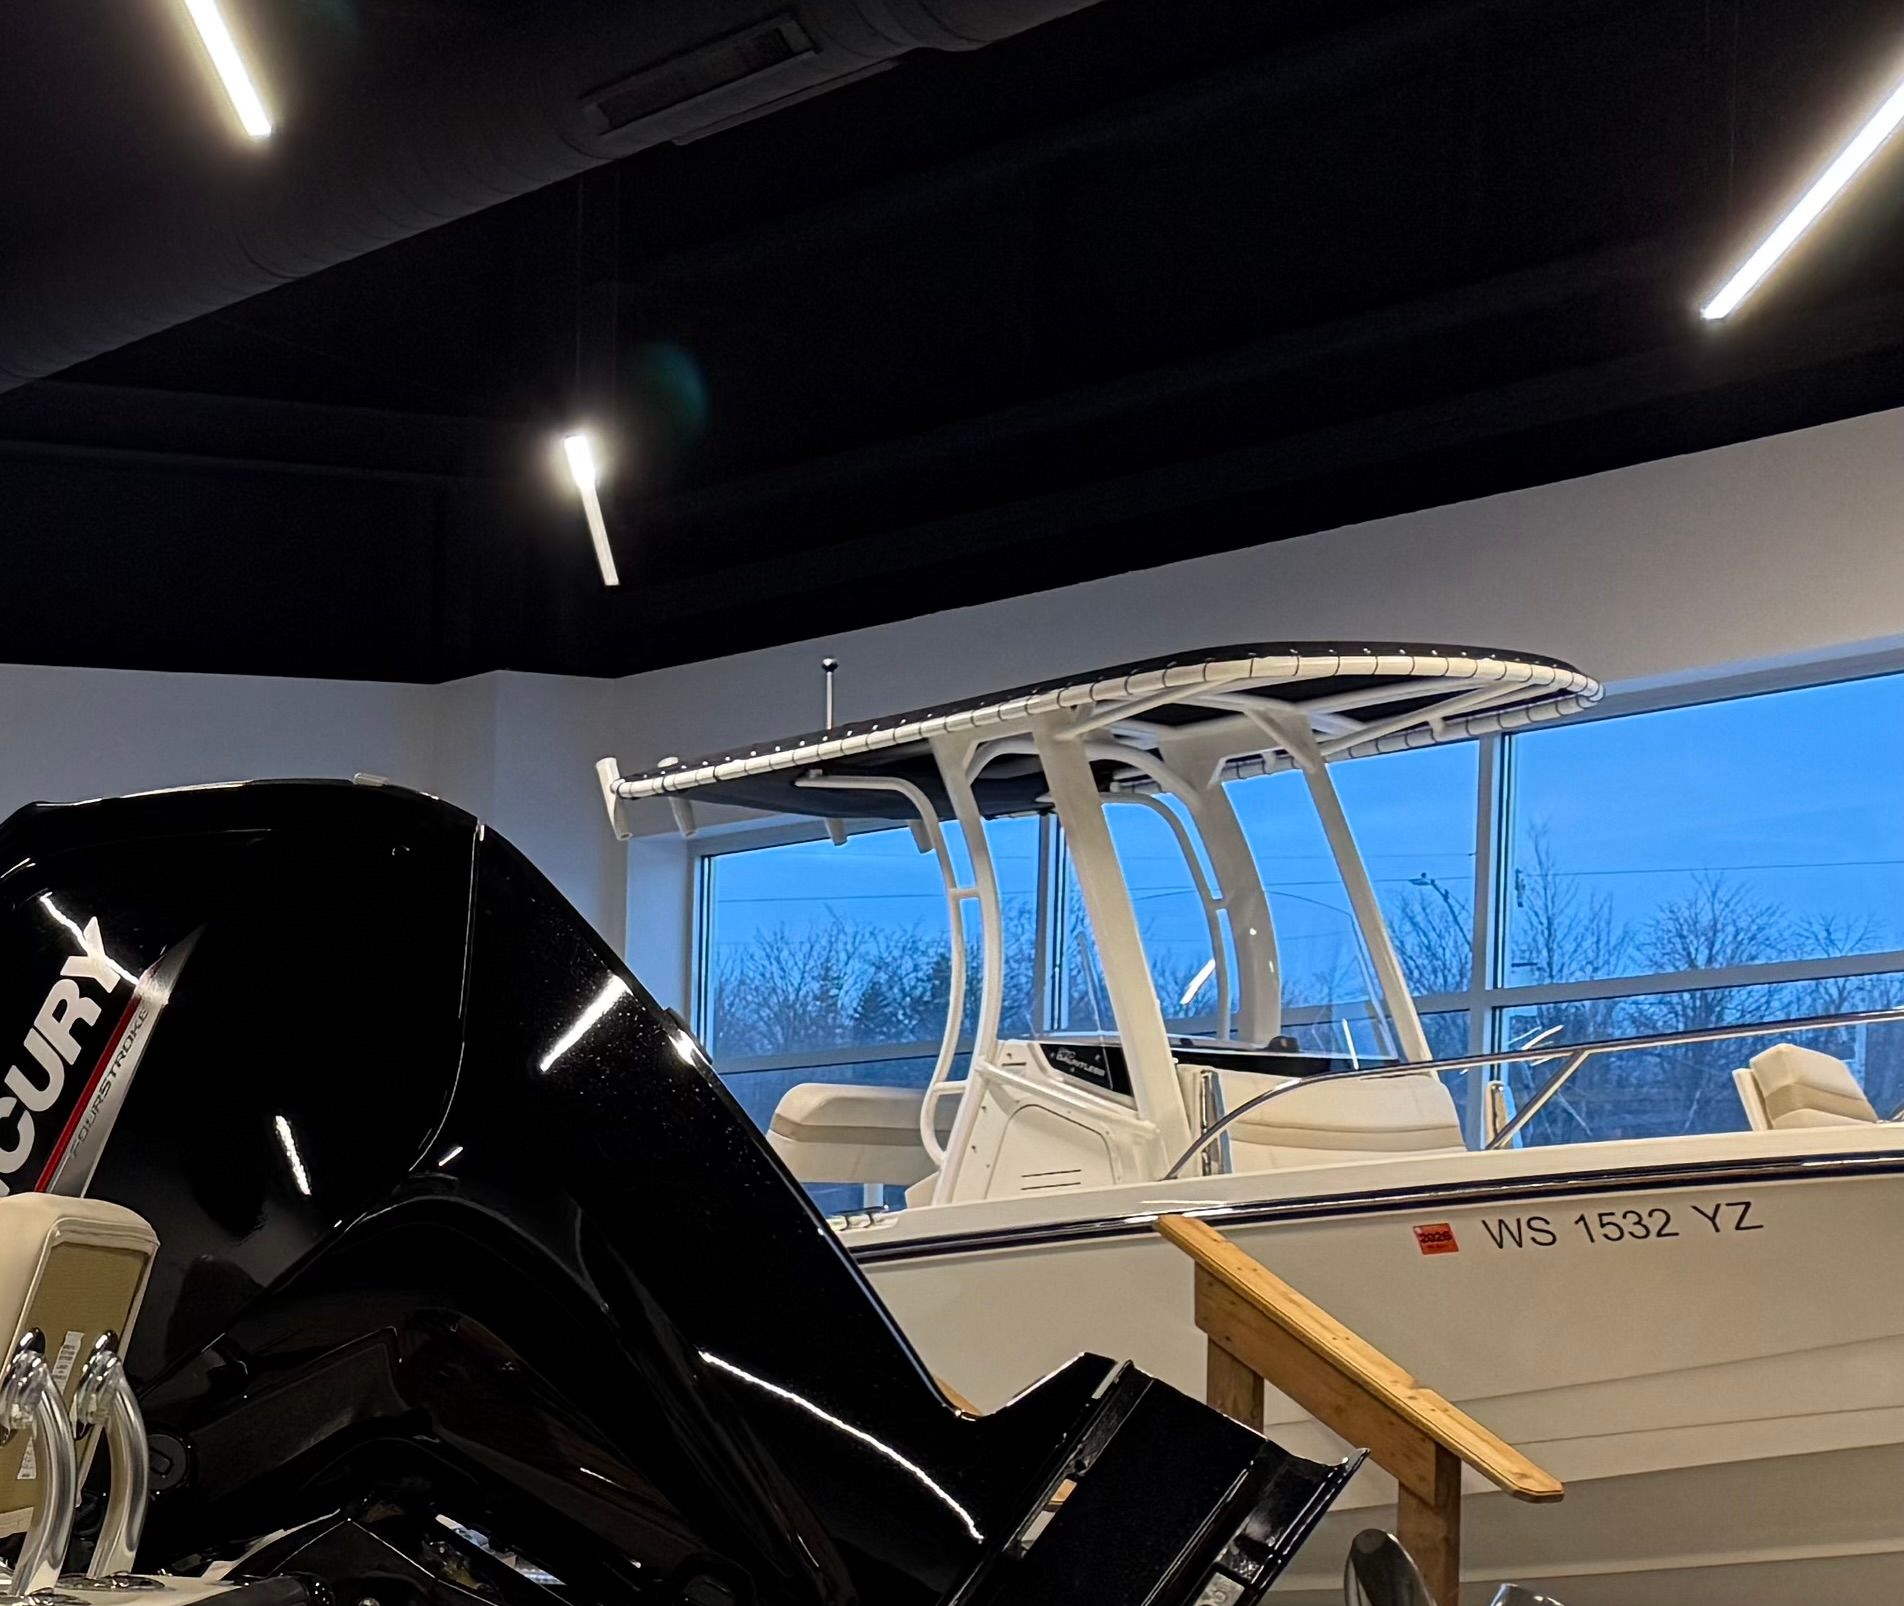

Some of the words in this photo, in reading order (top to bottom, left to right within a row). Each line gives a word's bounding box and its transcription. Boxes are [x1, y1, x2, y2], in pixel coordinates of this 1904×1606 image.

[69, 1006, 149, 1160] FOURSTROKE
[1481, 1216, 1558, 1249] WS
[1574, 1208, 1680, 1244] 1532
[1691, 1201, 1765, 1233] YZ
